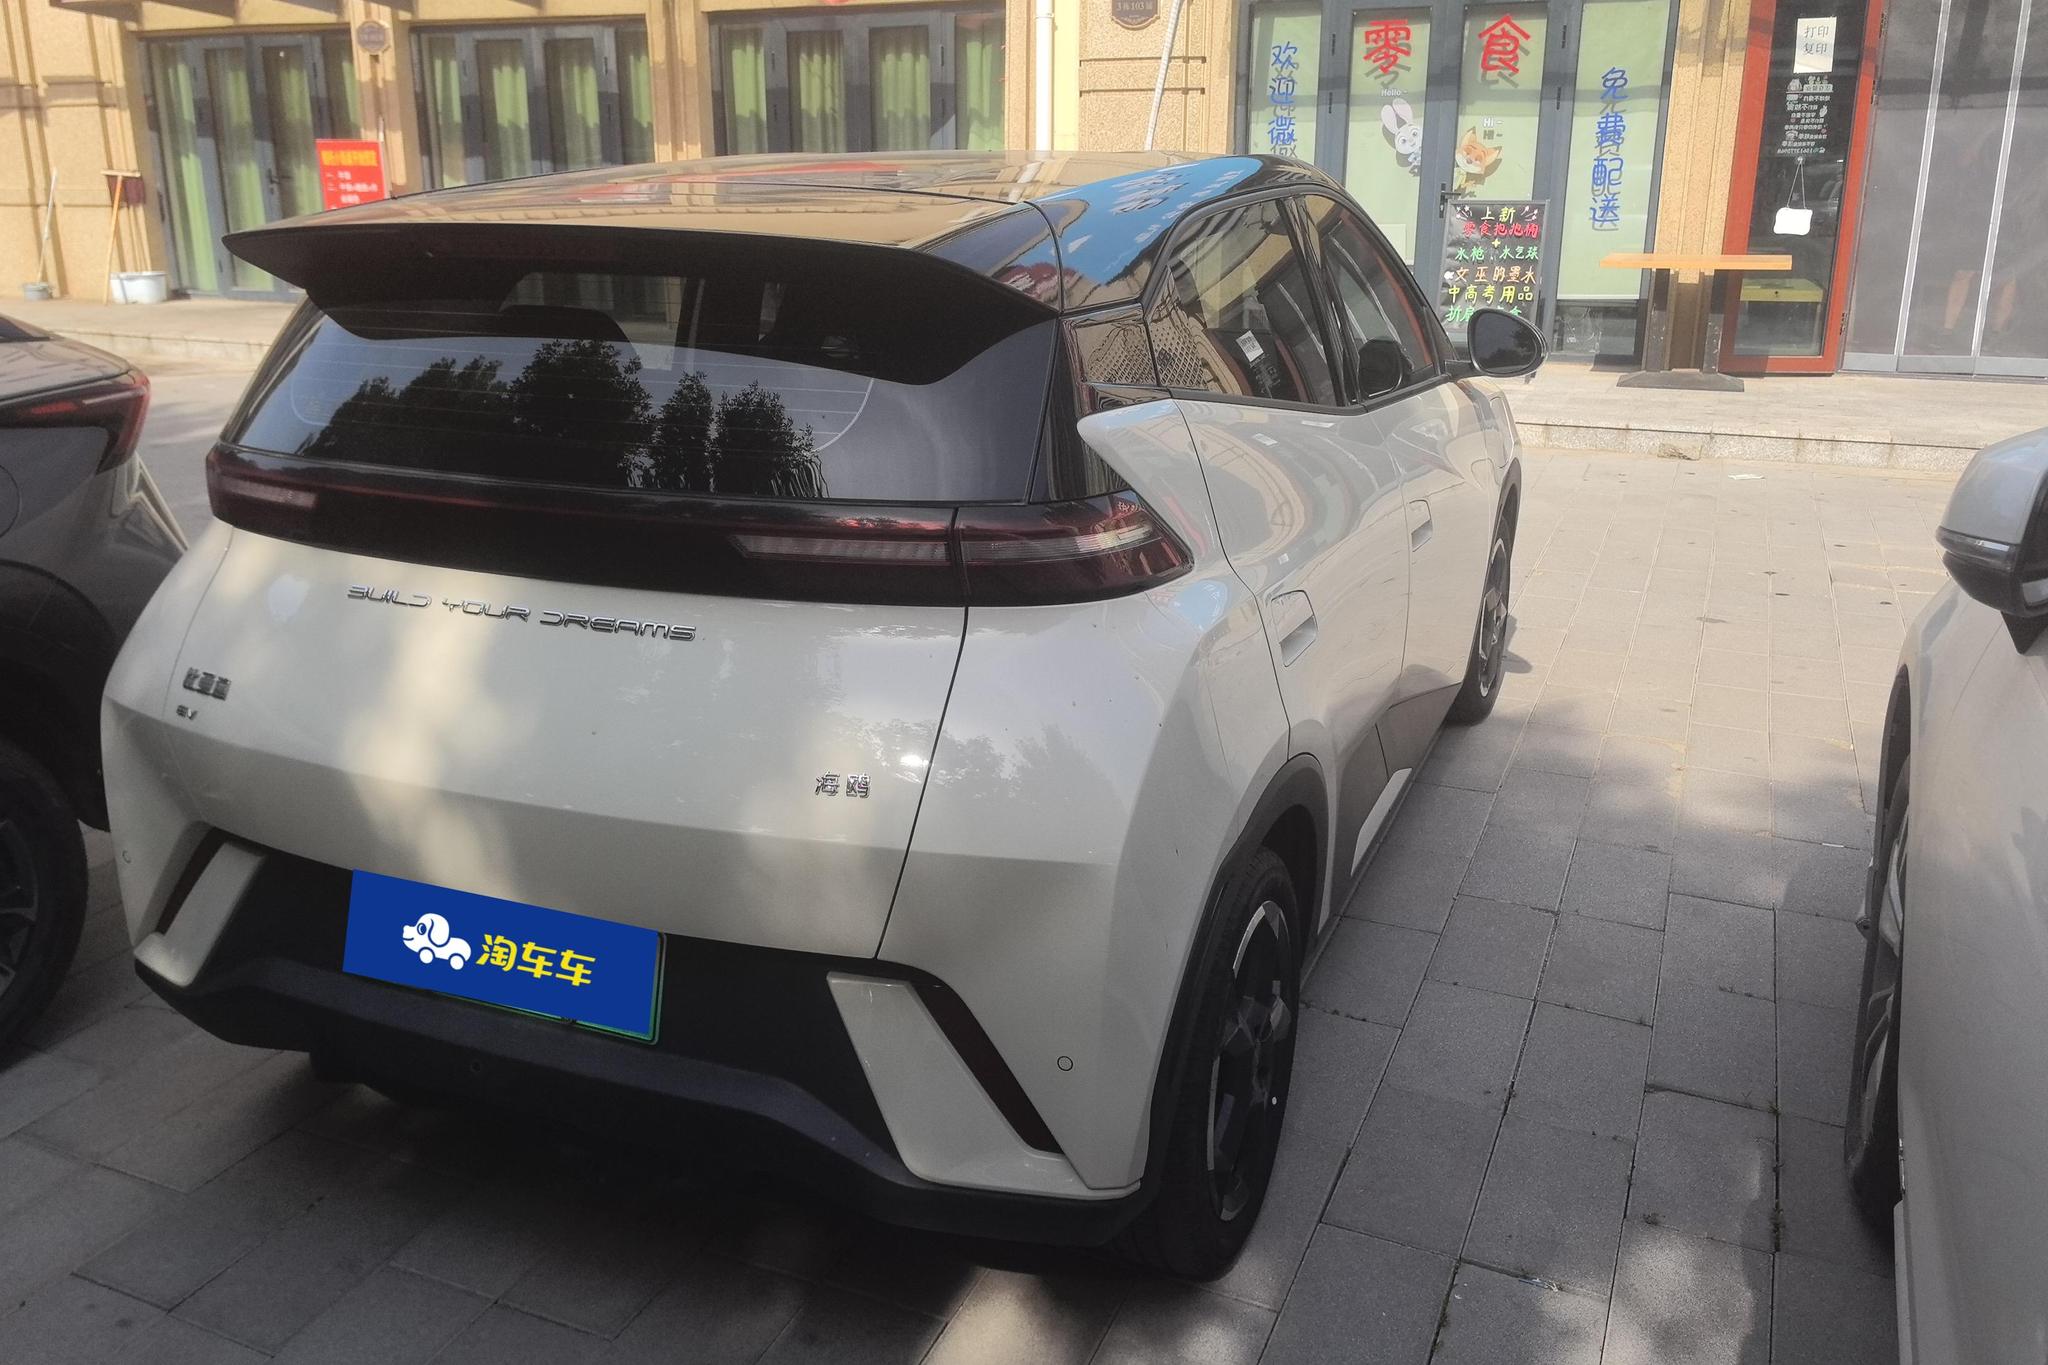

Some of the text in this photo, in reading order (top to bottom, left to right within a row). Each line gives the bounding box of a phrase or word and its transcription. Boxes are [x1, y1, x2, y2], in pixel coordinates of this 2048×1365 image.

[1804, 25, 1829, 39] 打印
[1802, 43, 1828, 55] 复印
[1590, 67, 1628, 223] 免费配送
[1481, 206, 1516, 224] 上新
[1448, 284, 1534, 304] 中高考用品
[347, 584, 697, 642] BUILD YOUR DREAMS
[814, 771, 871, 799] 海鸥
